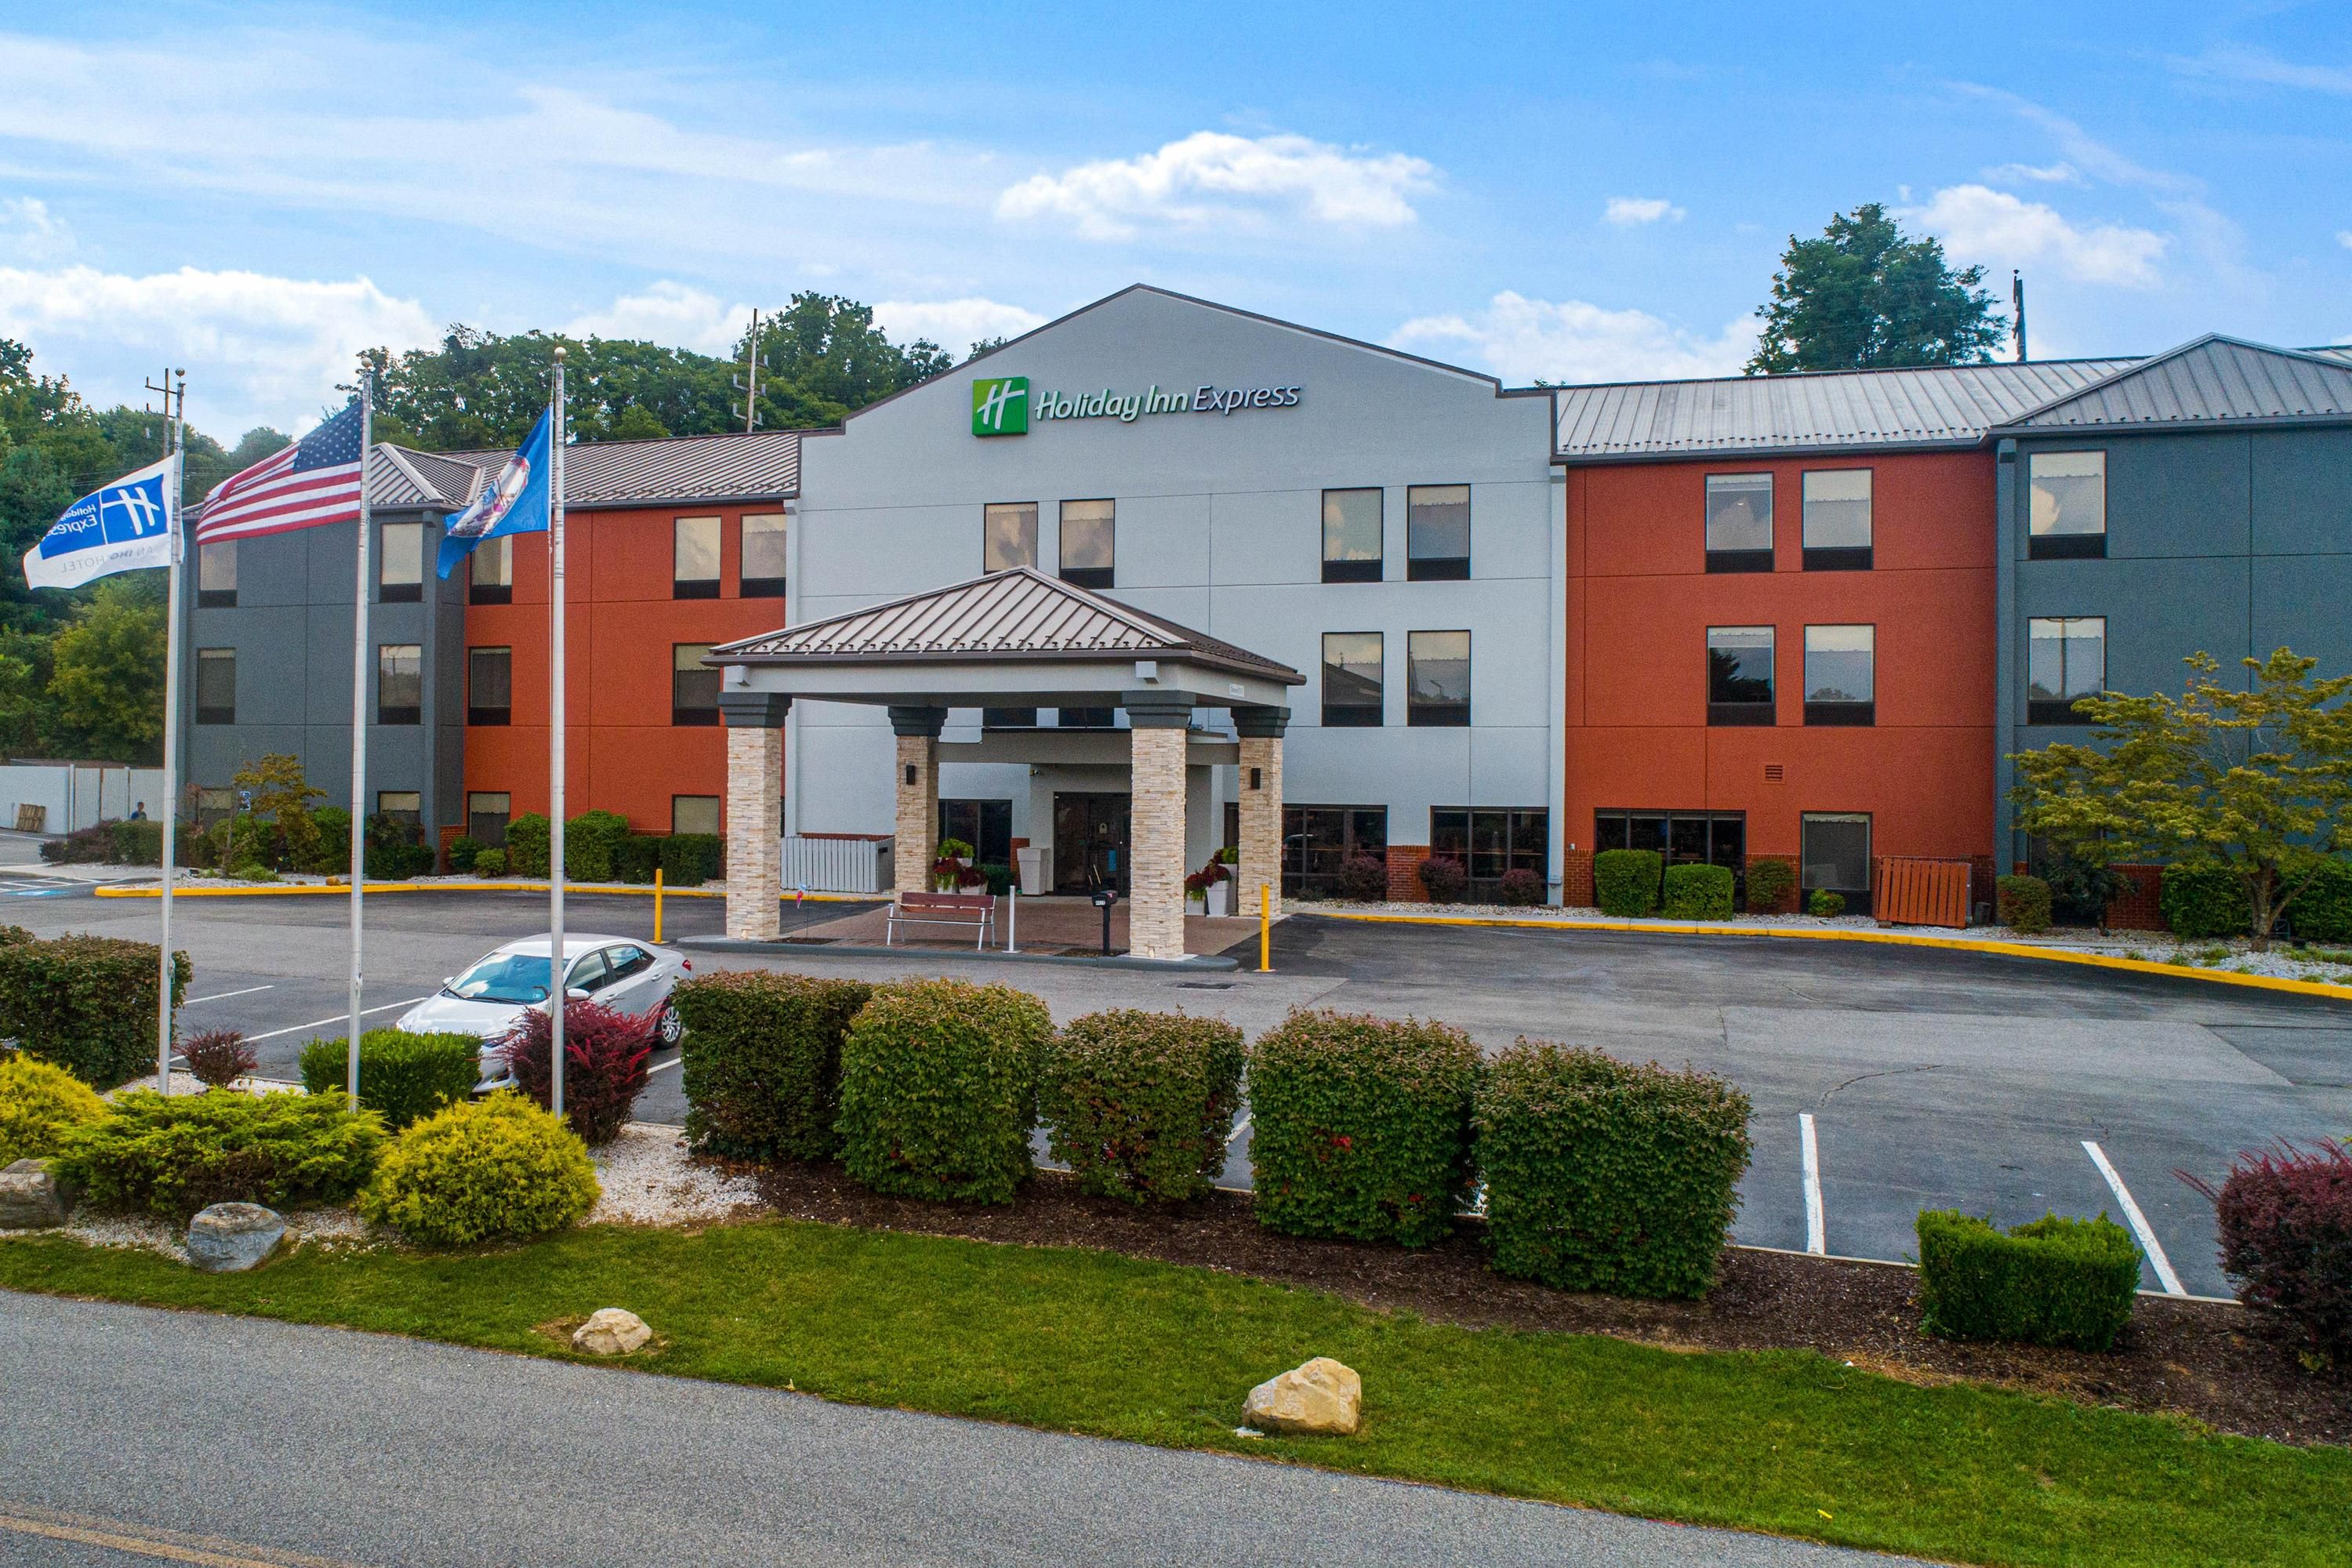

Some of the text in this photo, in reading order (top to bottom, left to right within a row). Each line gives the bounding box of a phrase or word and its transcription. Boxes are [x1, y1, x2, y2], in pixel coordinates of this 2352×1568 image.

[1035, 384, 1301, 423] Holiday Inn Express
